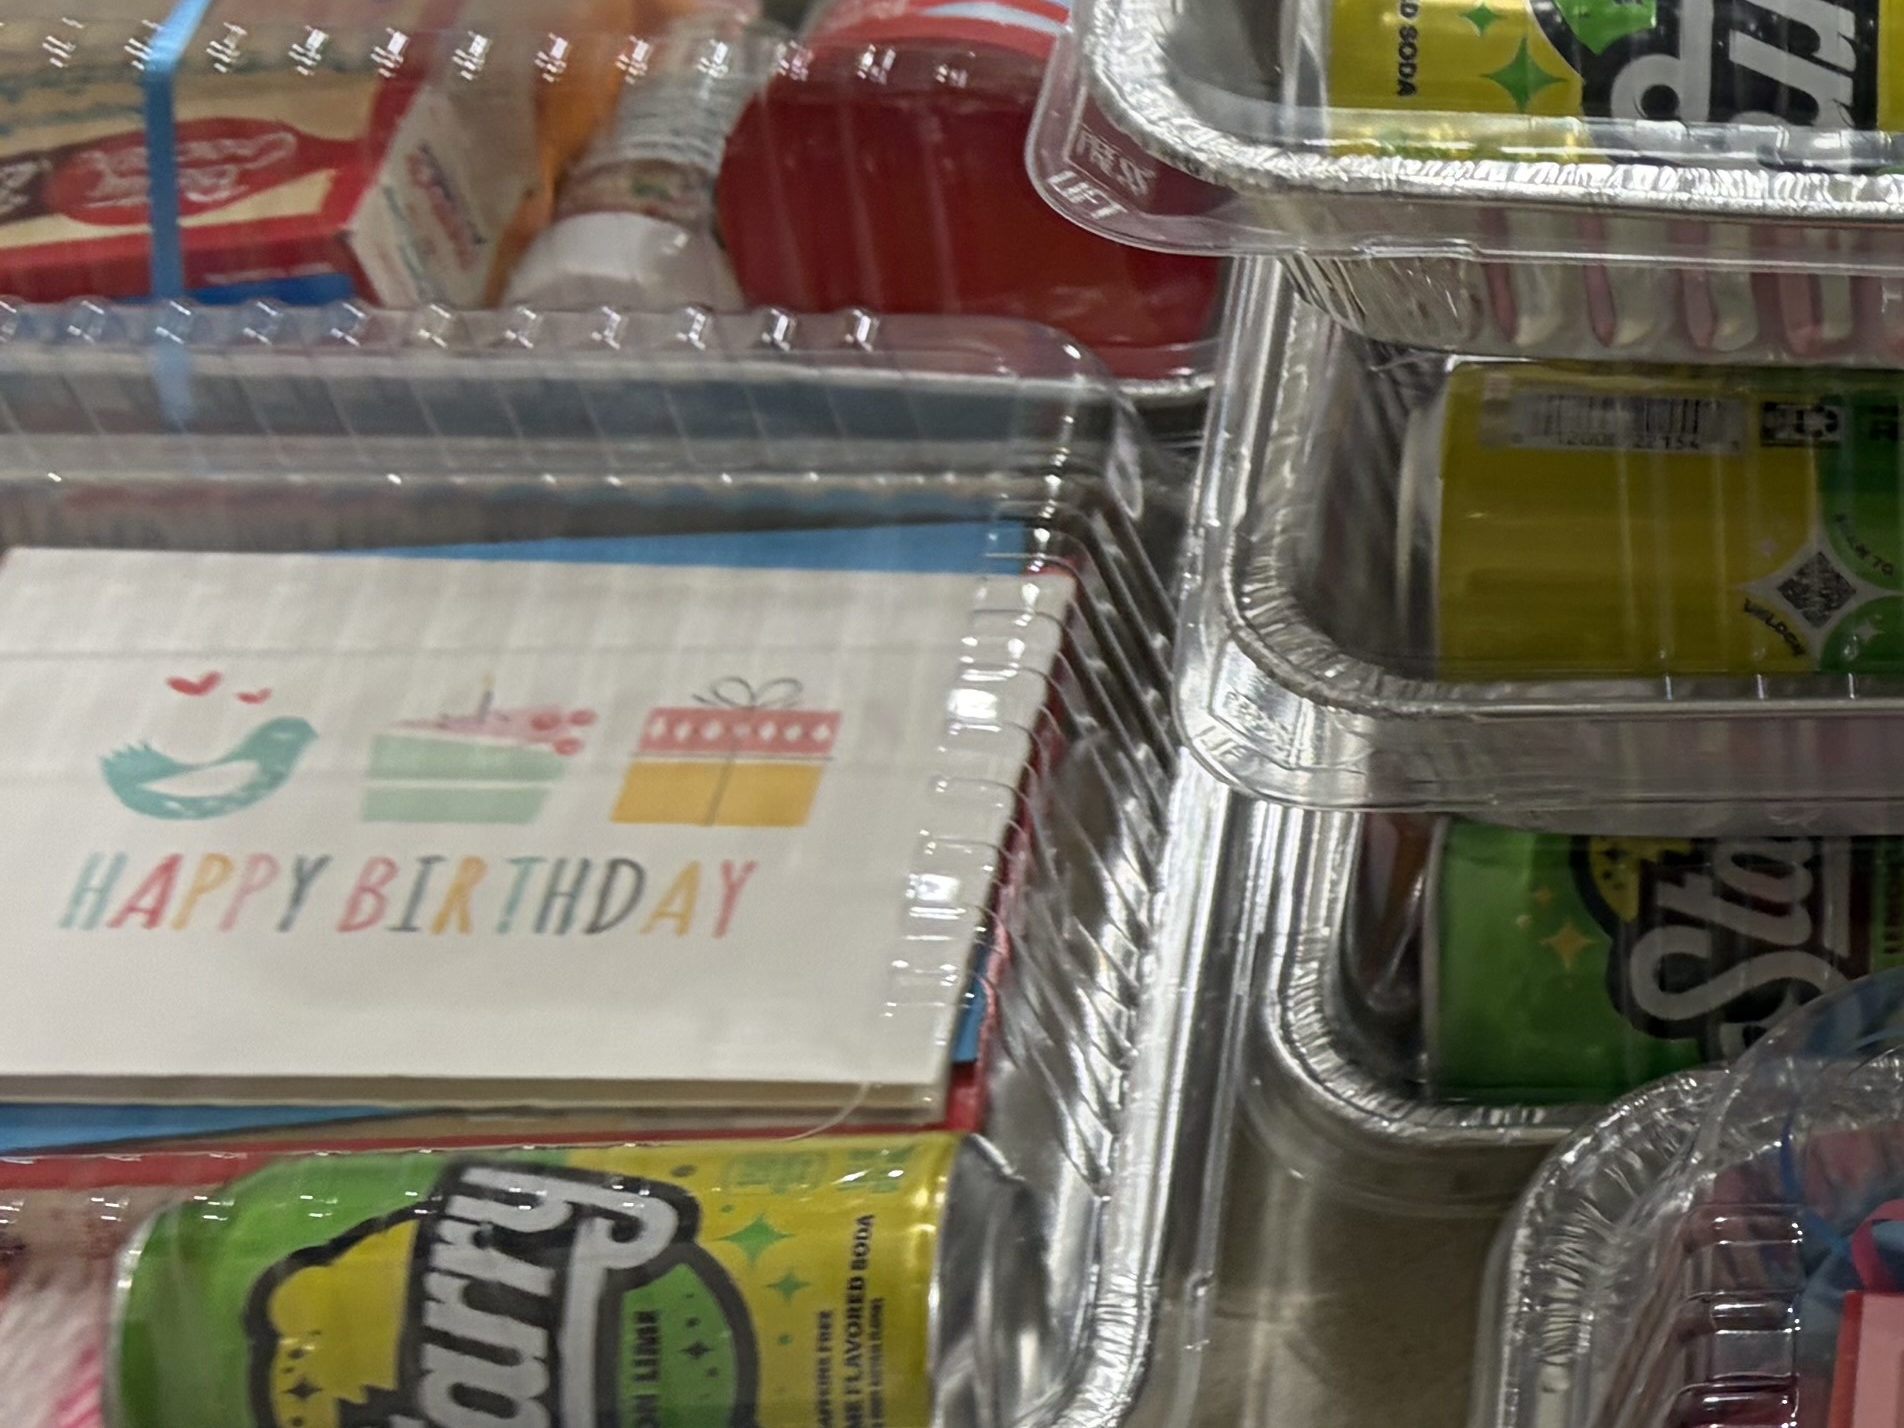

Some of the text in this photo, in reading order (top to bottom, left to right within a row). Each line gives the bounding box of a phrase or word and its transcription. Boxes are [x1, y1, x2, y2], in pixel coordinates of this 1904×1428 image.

[1398, 26, 1419, 99] SODA
[58, 852, 759, 940] HAPPY BIRTHDAY
